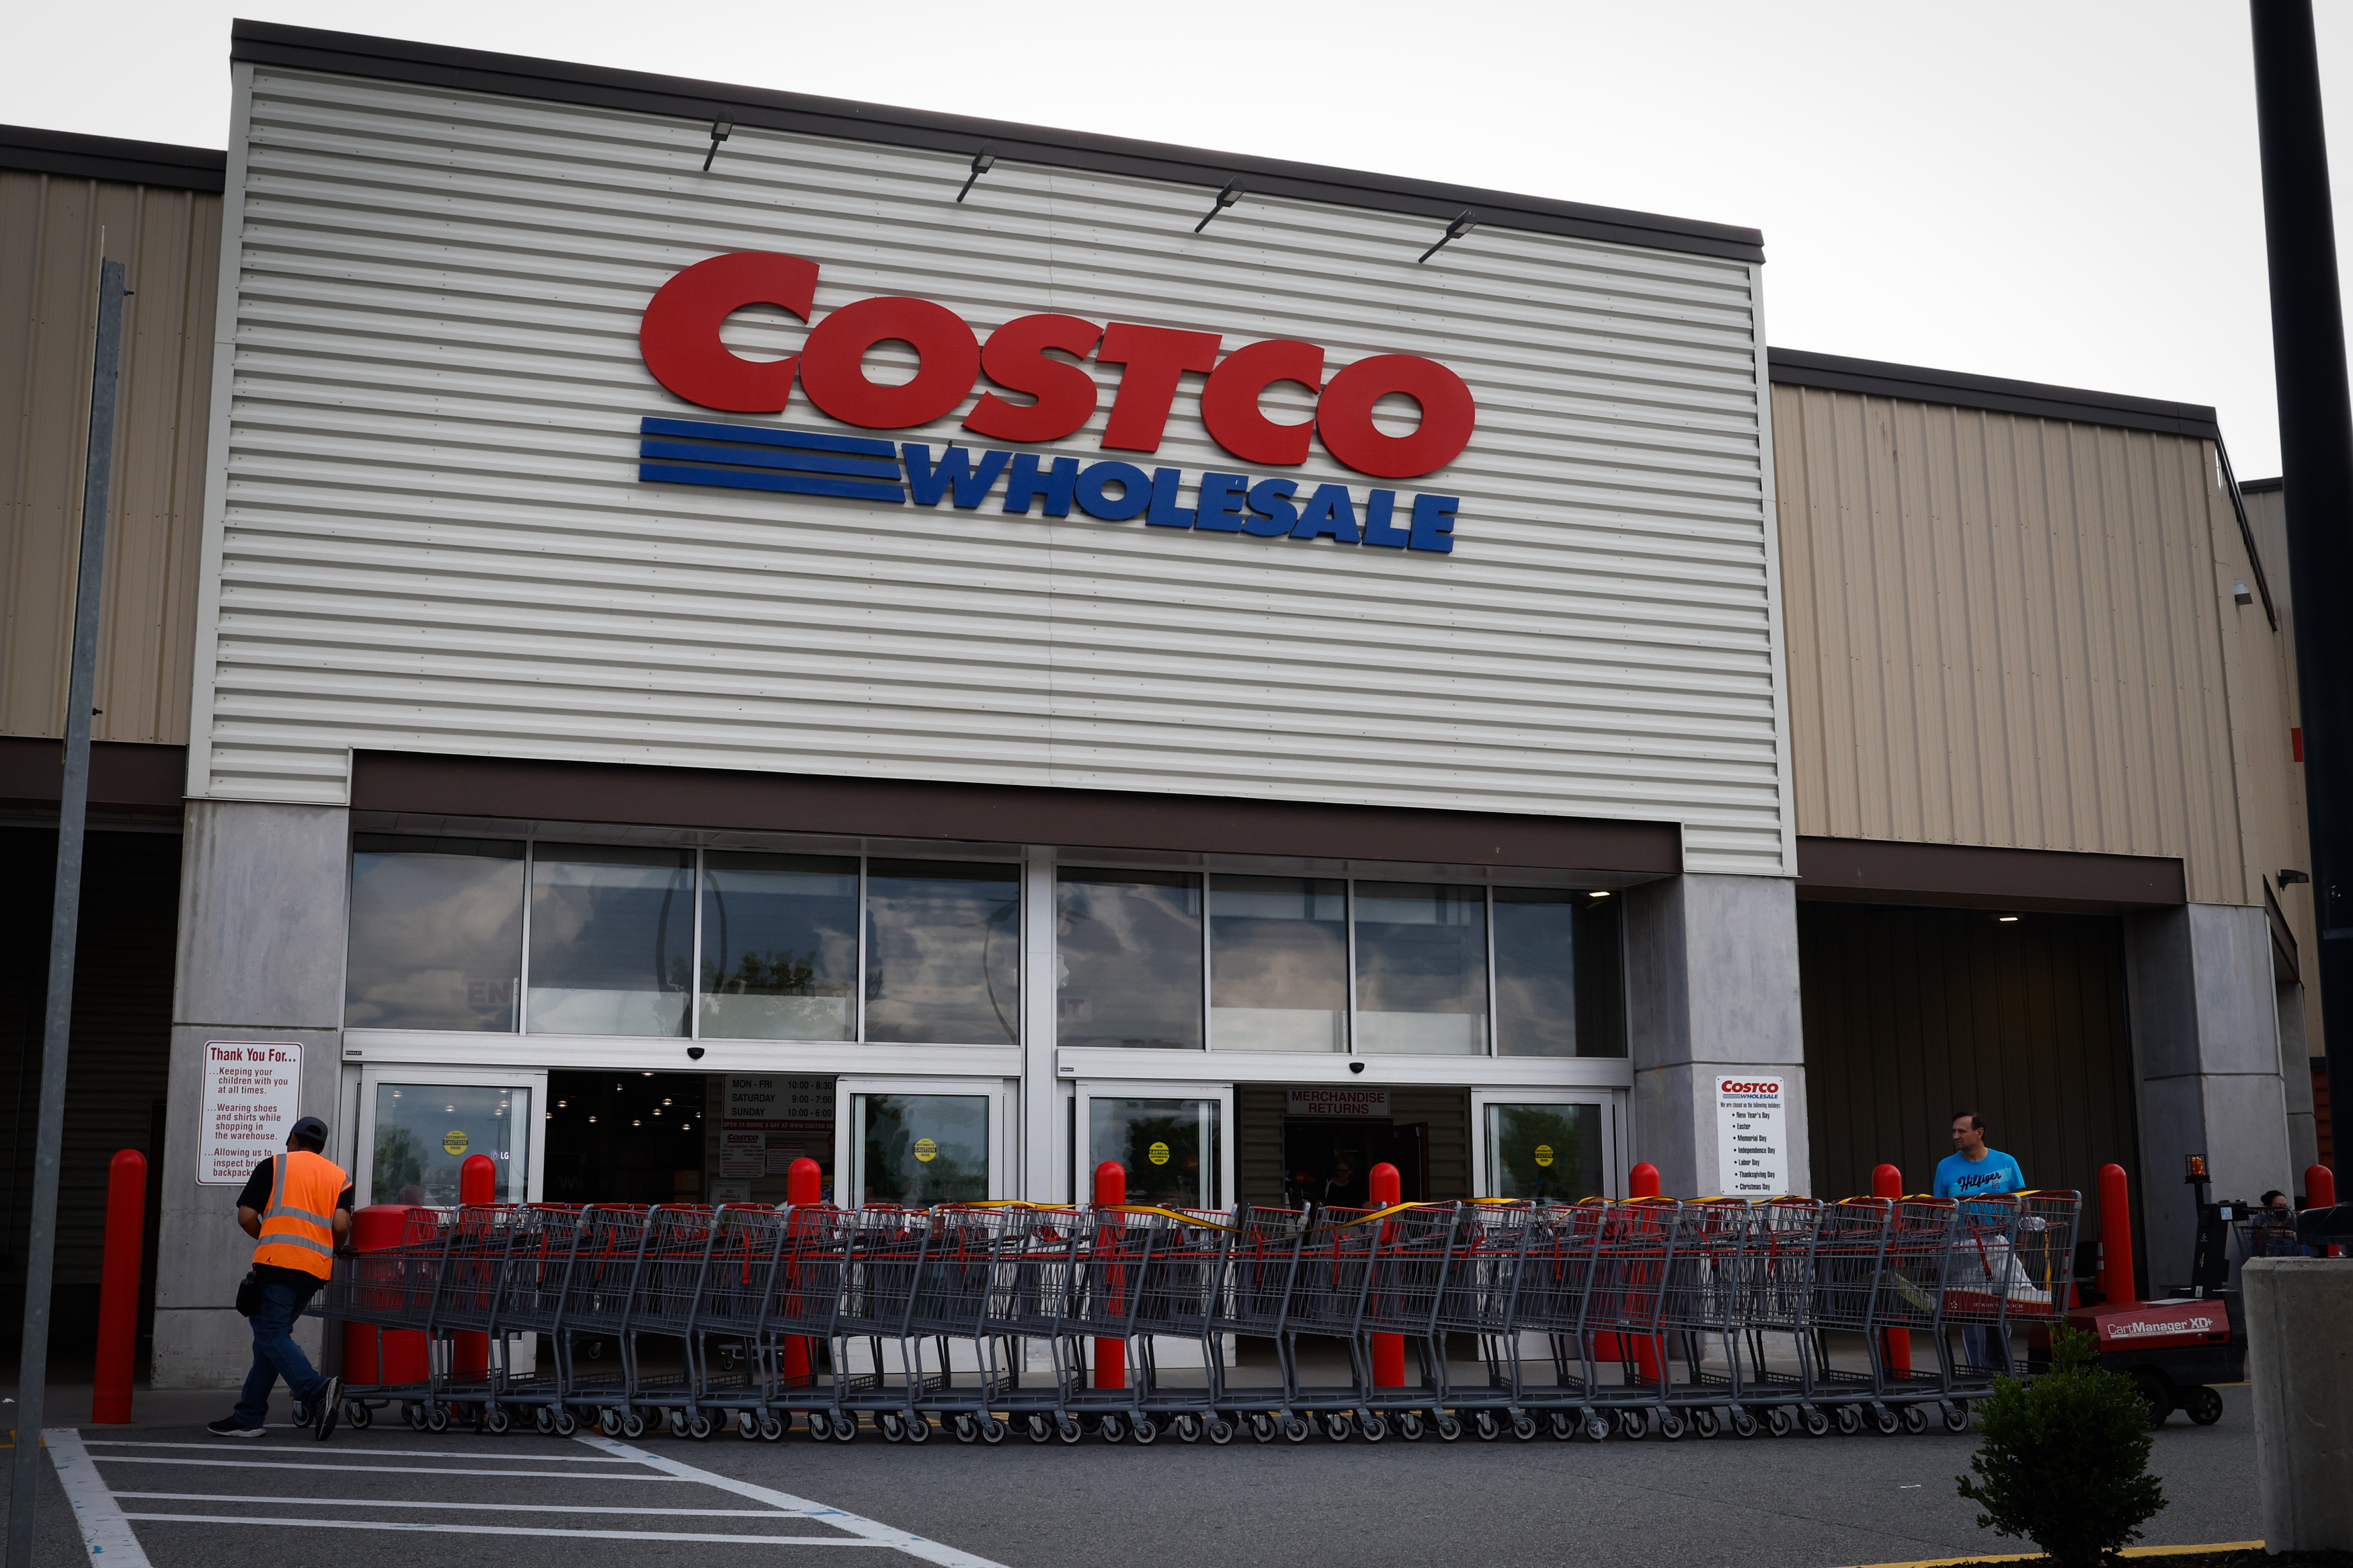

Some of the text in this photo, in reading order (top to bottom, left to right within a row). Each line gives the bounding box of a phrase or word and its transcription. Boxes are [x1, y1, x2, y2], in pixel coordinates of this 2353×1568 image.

[639, 251, 1476, 479] COSTCO
[901, 442, 1460, 552] WHOLESALE
[210, 1047, 296, 1062] Thank You For...
[218, 1077, 251, 1085] children
[274, 1079, 288, 1087] you
[732, 1079, 752, 1088] MON
[759, 1080, 772, 1088] FRI
[788, 1081, 809, 1089] 10:00
[815, 1081, 832, 1089] 8:30
[241, 1086, 267, 1094] times.
[1722, 1080, 1779, 1094] COSTCO
[732, 1094, 775, 1102] SATURDAY
[792, 1095, 809, 1103] 9:00
[815, 1096, 832, 1104] 7:00
[1291, 1090, 1385, 1103] MERCHANDISE
[253, 1104, 278, 1112] shoes
[731, 1108, 765, 1116] SUNDAY
[787, 1108, 809, 1117] 10:00
[815, 1109, 832, 1117] 6:00
[1308, 1103, 1369, 1114] RETURNS
[216, 1113, 281, 1122] and shirts while
[216, 1122, 253, 1132] shopping
[231, 1132, 278, 1141] warehouse.
[264, 1149, 272, 1157] to
[500, 1151, 509, 1159] LG
[213, 1159, 243, 1169] inspect
[1957, 1172, 2001, 1192] Hilfiger
[2199, 1251, 2205, 1268] 4
[2108, 1321, 2187, 1335] CartManager
